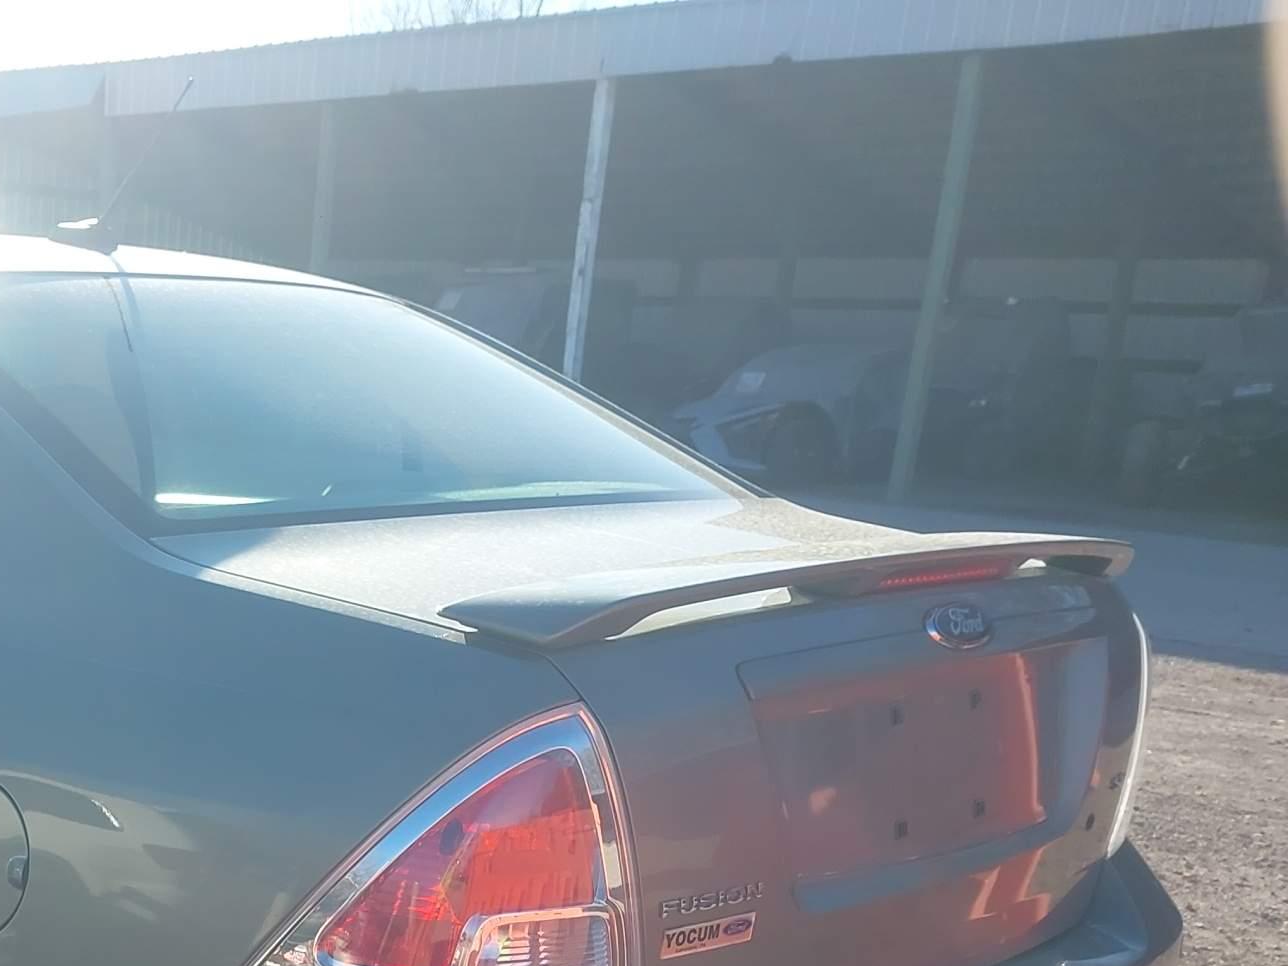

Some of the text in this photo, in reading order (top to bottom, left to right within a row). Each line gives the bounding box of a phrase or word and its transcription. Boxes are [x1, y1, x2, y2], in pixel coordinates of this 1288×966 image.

[948, 607, 984, 636] Ford
[658, 882, 765, 919] FUSION
[665, 923, 721, 949] YOCUM
